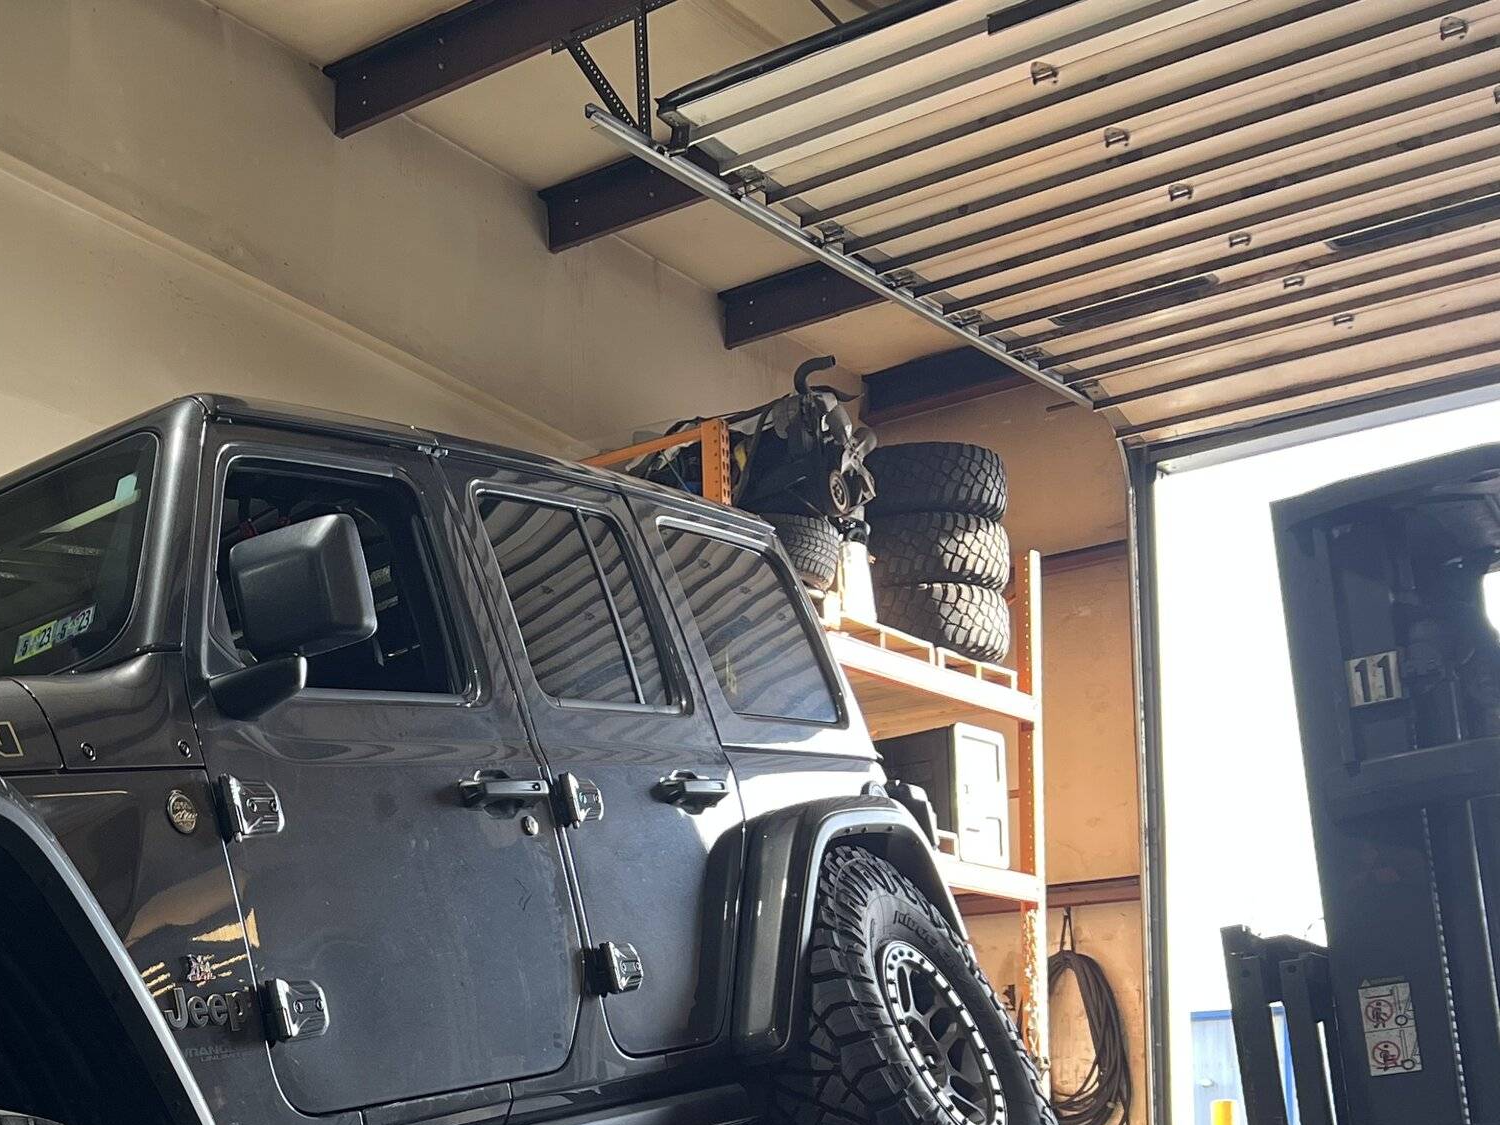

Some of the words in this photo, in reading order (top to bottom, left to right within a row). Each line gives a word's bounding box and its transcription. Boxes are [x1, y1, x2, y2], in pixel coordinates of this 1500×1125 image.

[79, 609, 91, 631] 23
[40, 627, 52, 647] 23
[1354, 654, 1395, 703] 11
[164, 987, 248, 1031] Jeep
